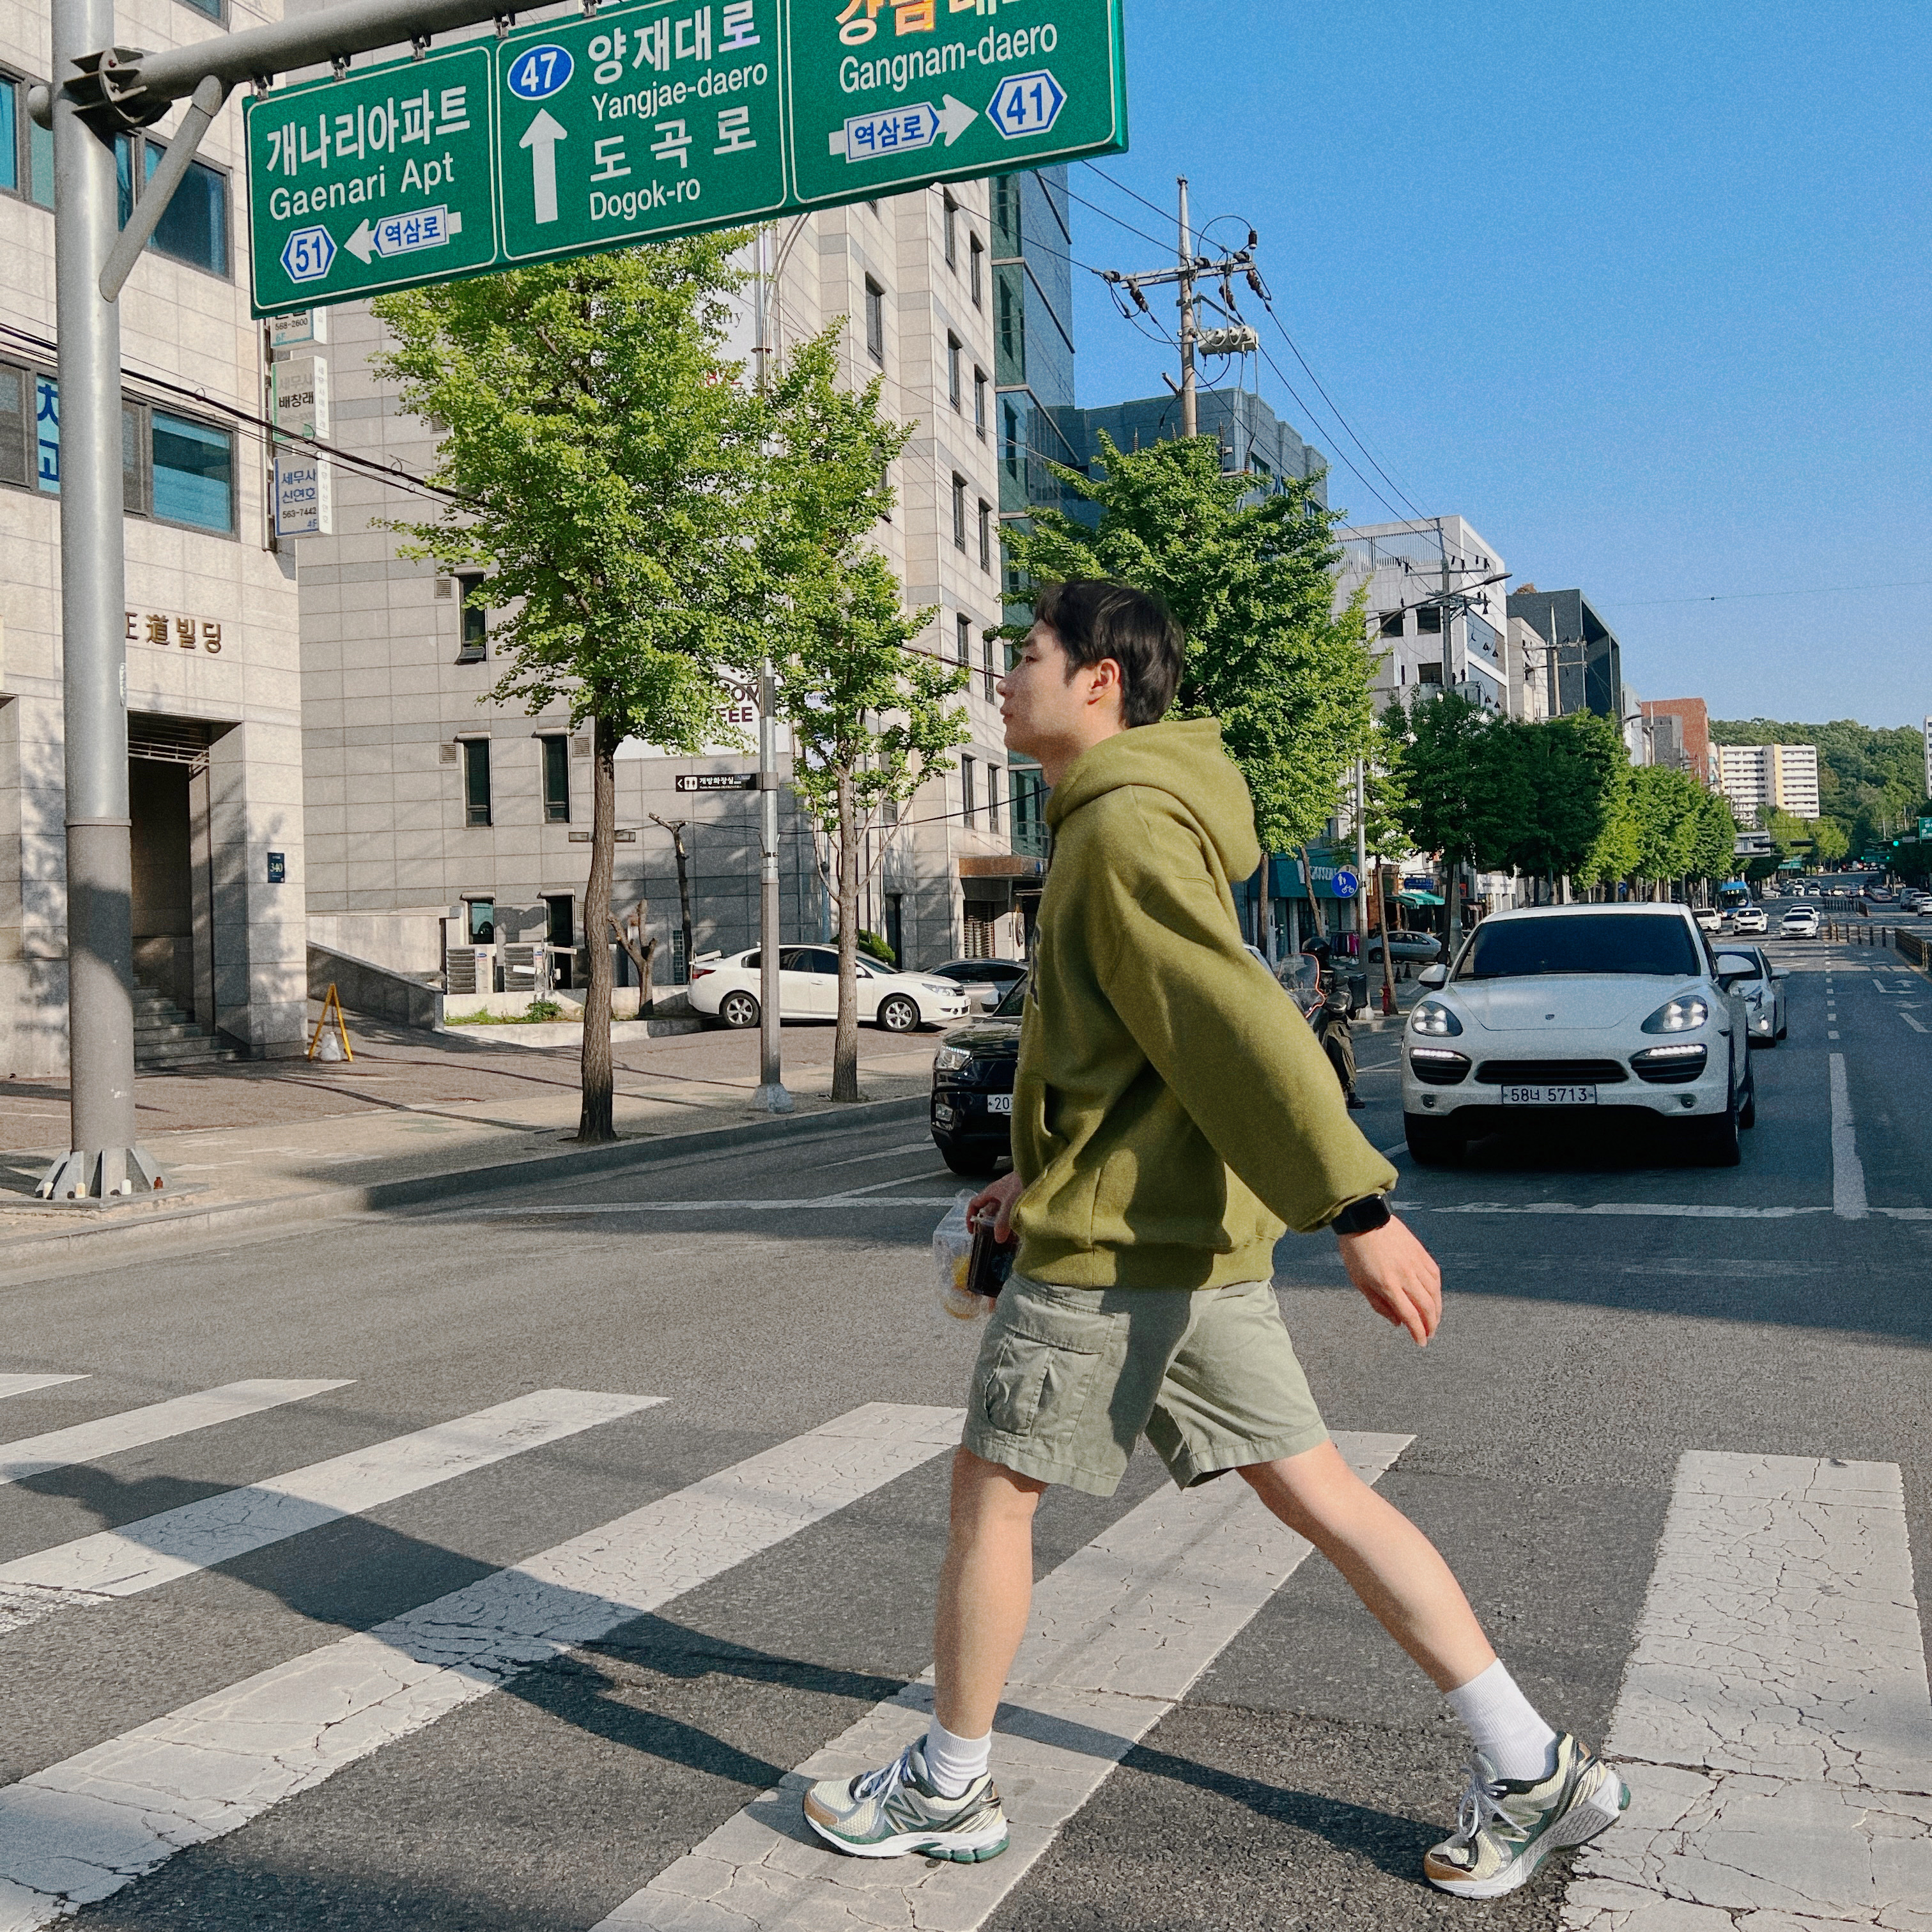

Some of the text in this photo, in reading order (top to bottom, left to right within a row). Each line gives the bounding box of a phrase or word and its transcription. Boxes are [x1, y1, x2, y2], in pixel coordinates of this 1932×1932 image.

[588, 0, 760, 84] 양재대로
[835, 0, 1023, 45] 강남
[521, 50, 558, 92] 47
[840, 24, 1058, 93] Gangnam-daero
[592, 63, 768, 121] Yangjae-daero
[1006, 82, 1043, 125] 41
[267, 86, 470, 176] 개나리아파트
[854, 115, 925, 151] 역삼로
[269, 151, 454, 220] Gaenari Apt
[589, 180, 700, 220] Dogok-ro
[385, 217, 441, 247] 역삼로
[295, 235, 324, 273] 51
[279, 391, 314, 408] 배창래
[282, 468, 316, 484] 세무사
[282, 488, 316, 504] 신연호
[994, 1097, 1013, 1110] 20
[1511, 1088, 1588, 1102] 58너 5713
